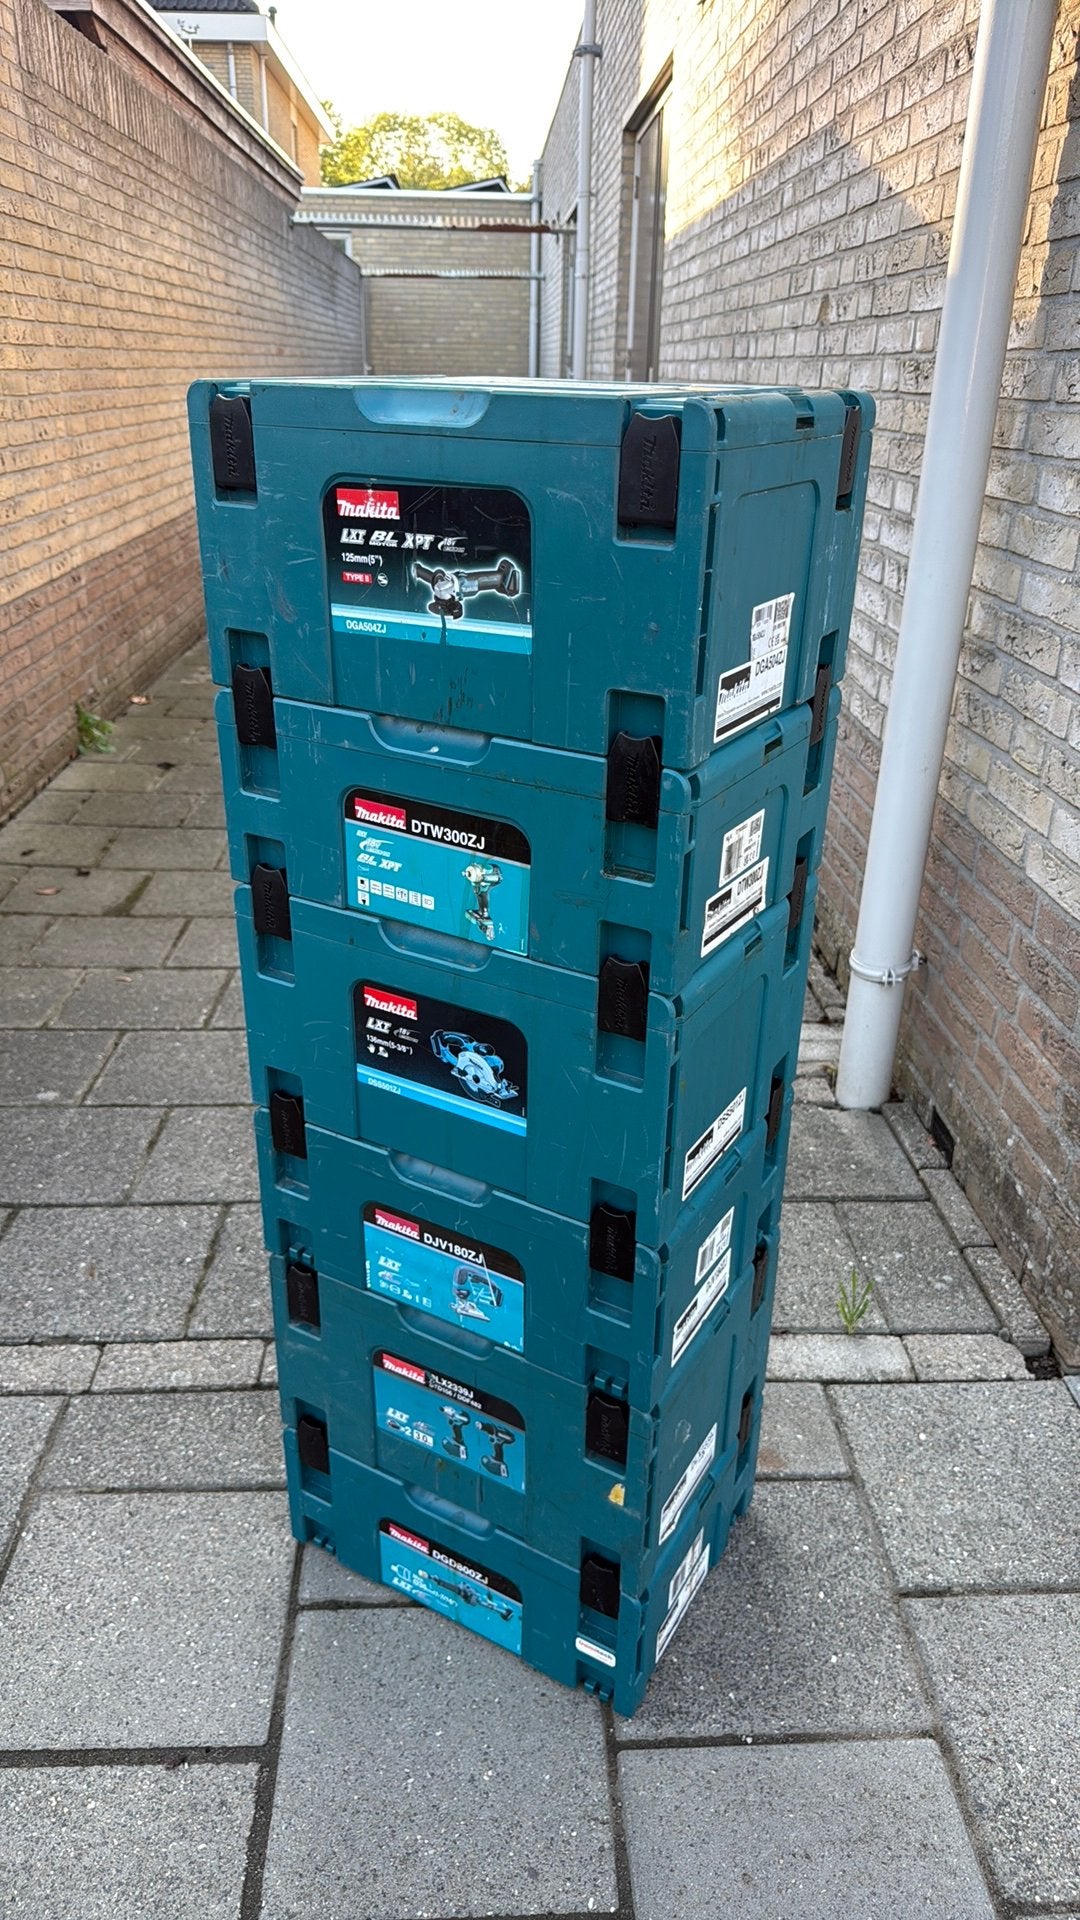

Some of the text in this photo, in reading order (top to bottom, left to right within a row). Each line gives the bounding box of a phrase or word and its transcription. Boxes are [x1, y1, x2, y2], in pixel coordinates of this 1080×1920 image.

[340, 528, 367, 545] LXT
[369, 530, 398, 542] BL
[401, 532, 435, 550] XPT
[345, 572, 364, 582] TYPE
[346, 619, 386, 634] DGA504ZJ
[411, 819, 486, 850] DTW300ZJ
[378, 858, 403, 872] XPT
[365, 1016, 392, 1034] LXT
[423, 1232, 484, 1264] DJV180ZJ
[378, 1255, 402, 1272] LXT
[386, 1406, 410, 1423] LXT
[432, 1549, 489, 1585] DGD800ZJ
